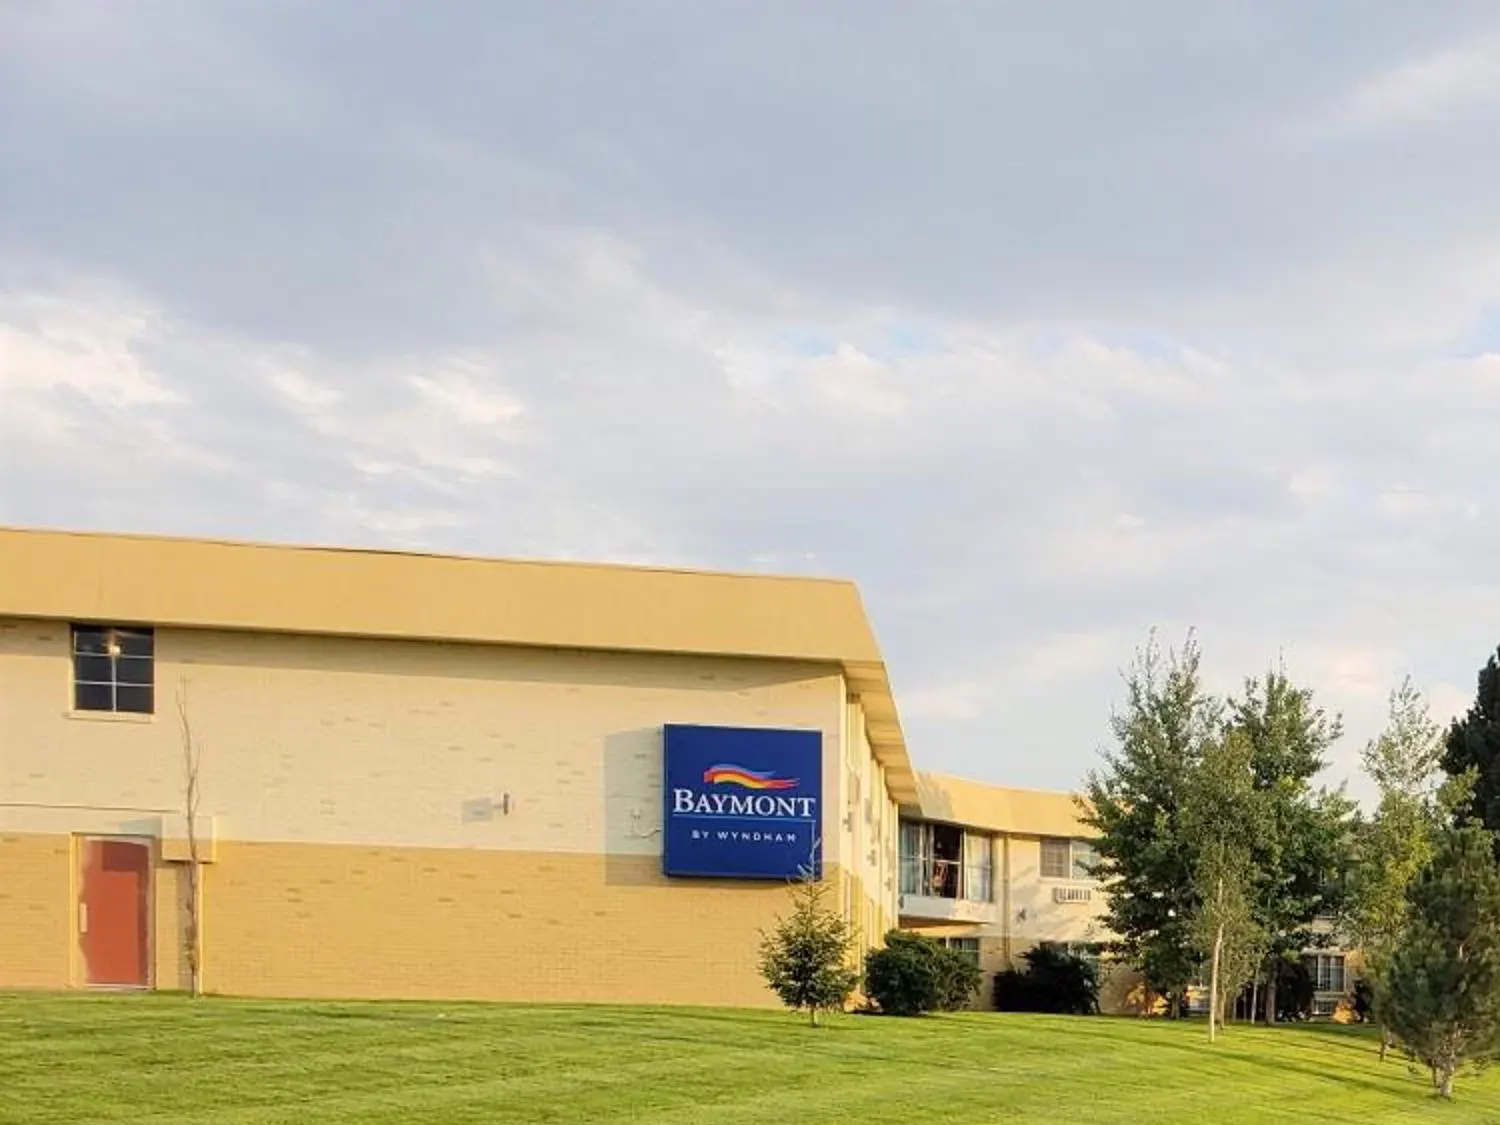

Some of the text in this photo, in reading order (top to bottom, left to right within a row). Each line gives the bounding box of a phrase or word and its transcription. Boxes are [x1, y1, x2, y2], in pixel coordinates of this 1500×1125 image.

[673, 789, 816, 817] BAYMONT
[692, 829, 796, 842] BY WYNDHAM
